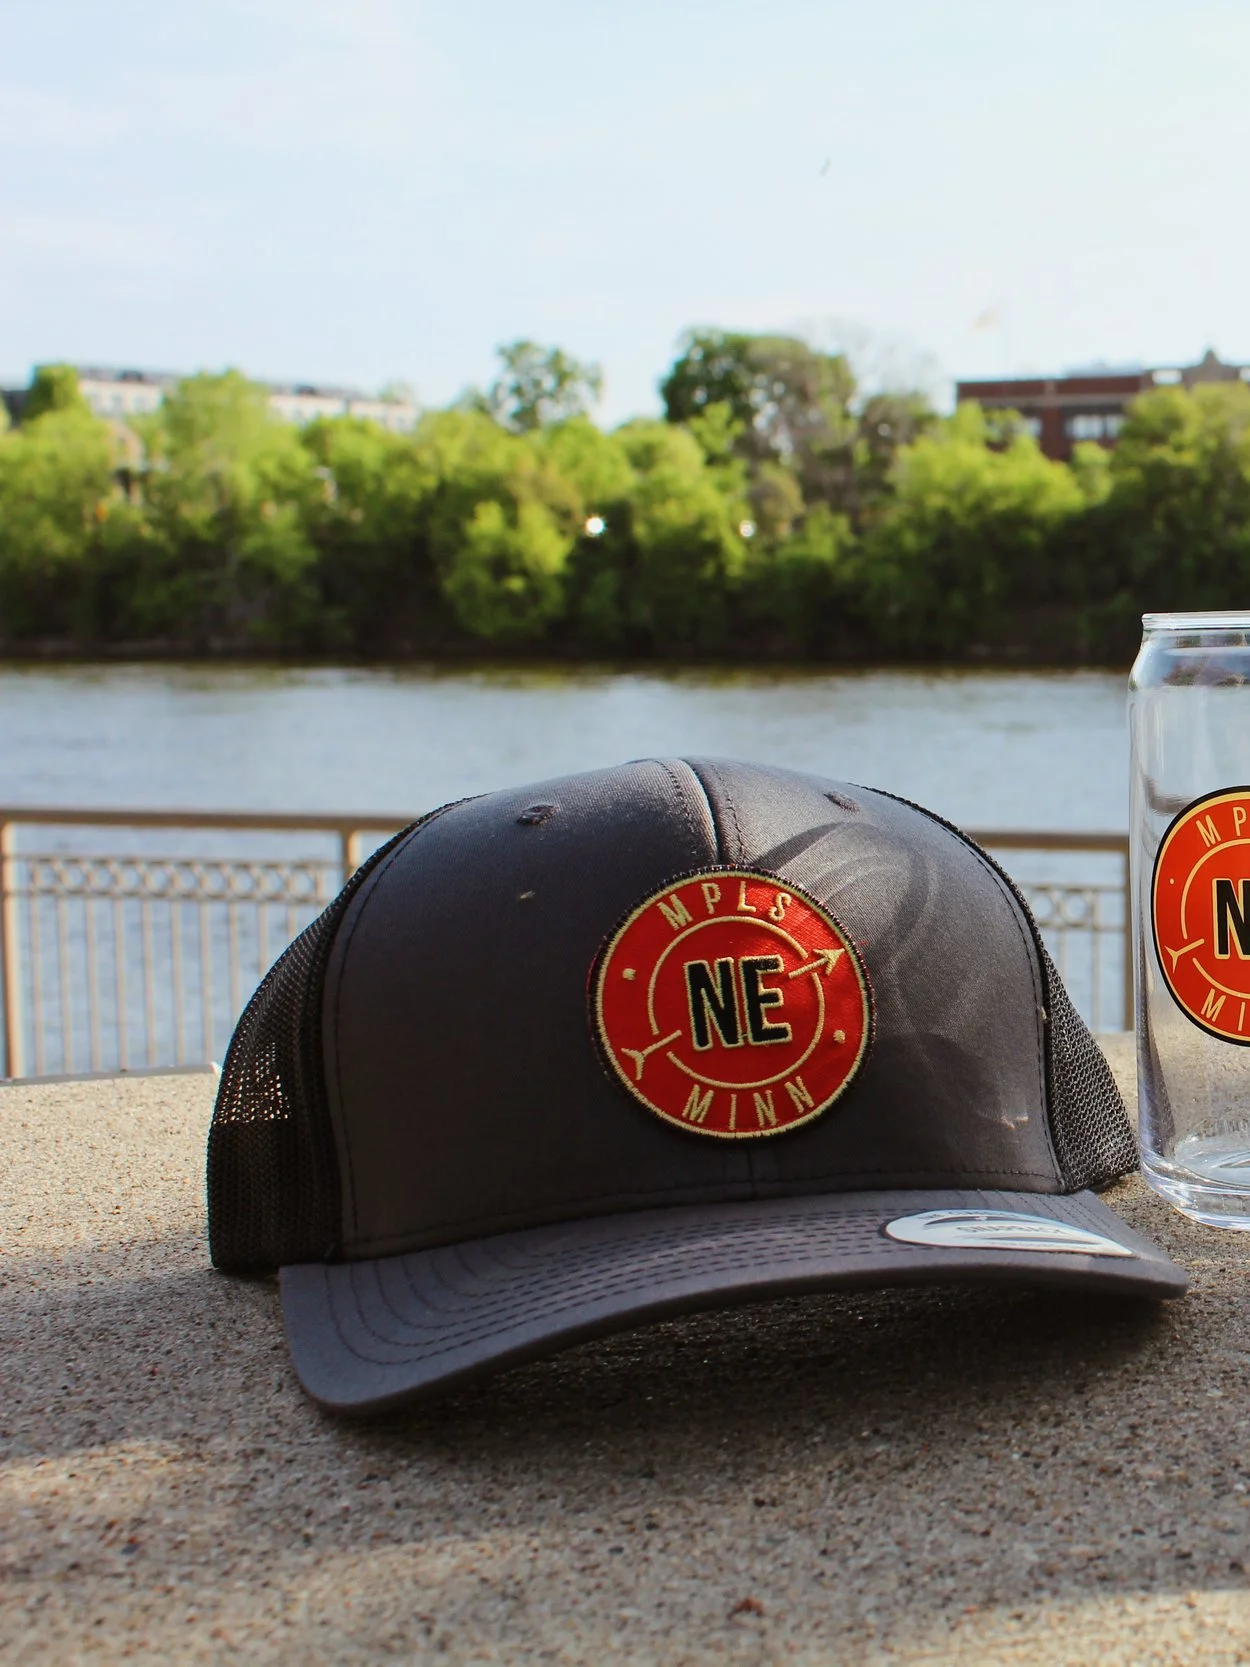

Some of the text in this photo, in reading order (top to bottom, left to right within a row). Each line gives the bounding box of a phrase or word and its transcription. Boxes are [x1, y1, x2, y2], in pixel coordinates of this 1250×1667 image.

[656, 880, 792, 930] MPLS
[684, 953, 793, 1051] NE
[681, 1075, 815, 1131] MINN
